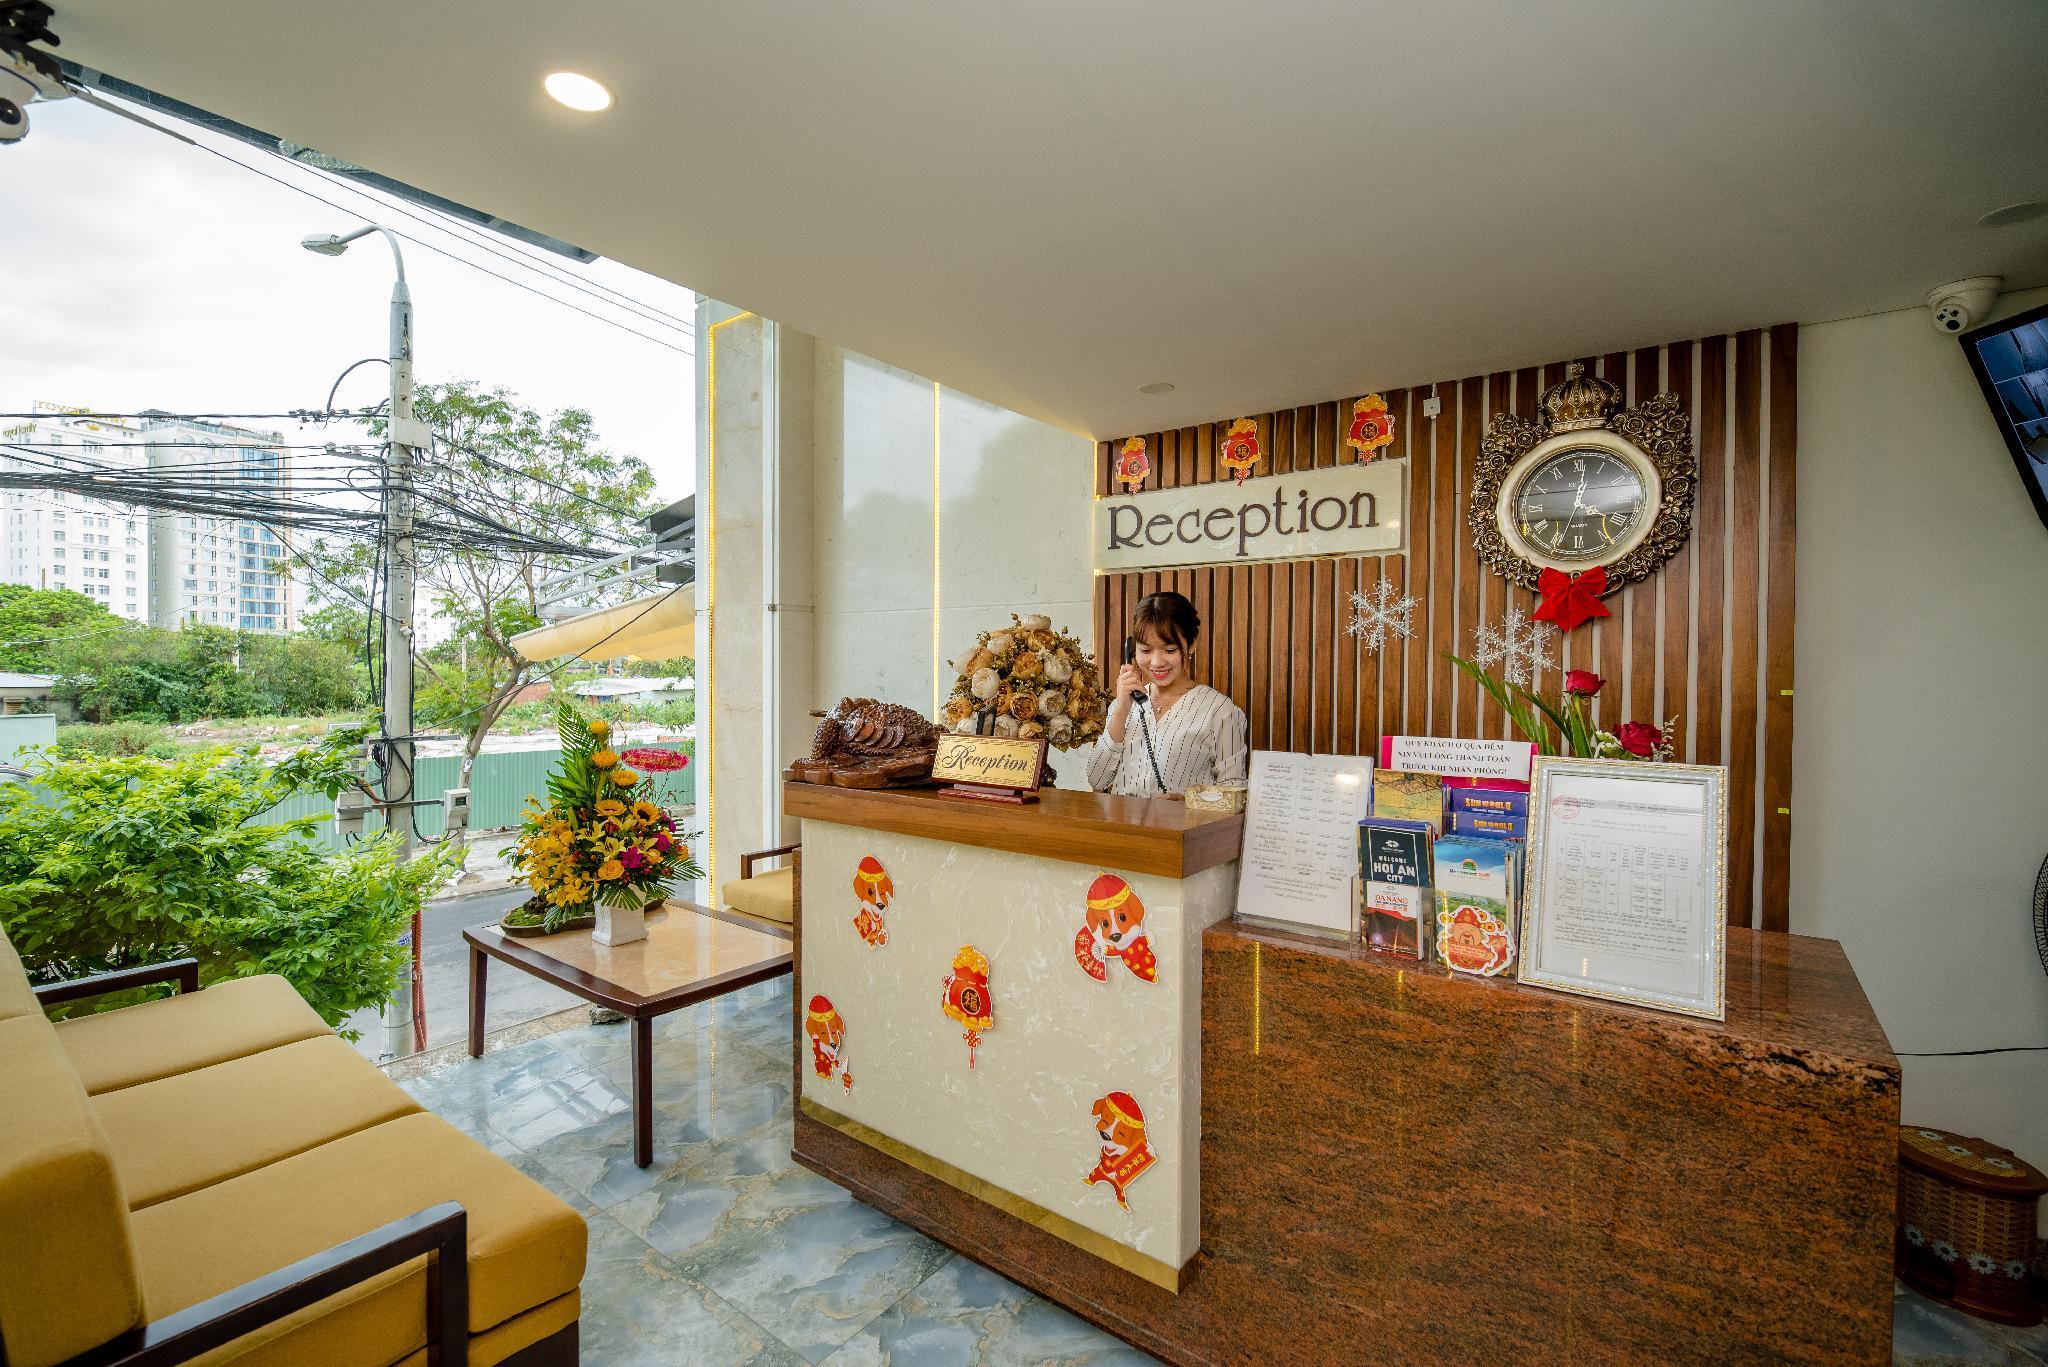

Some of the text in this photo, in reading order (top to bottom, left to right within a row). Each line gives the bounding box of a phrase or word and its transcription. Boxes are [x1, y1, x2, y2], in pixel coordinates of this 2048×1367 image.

[1107, 485, 1379, 557] Reception
[1464, 743, 1482, 751] QUA
[941, 745, 1028, 774] Reception
[1455, 754, 1484, 762] THANH
[1431, 764, 1446, 772] KHI
[1378, 855, 1407, 864] WELCOME
[1373, 862, 1416, 878] HOI AN
[1386, 873, 1404, 883] CITY
